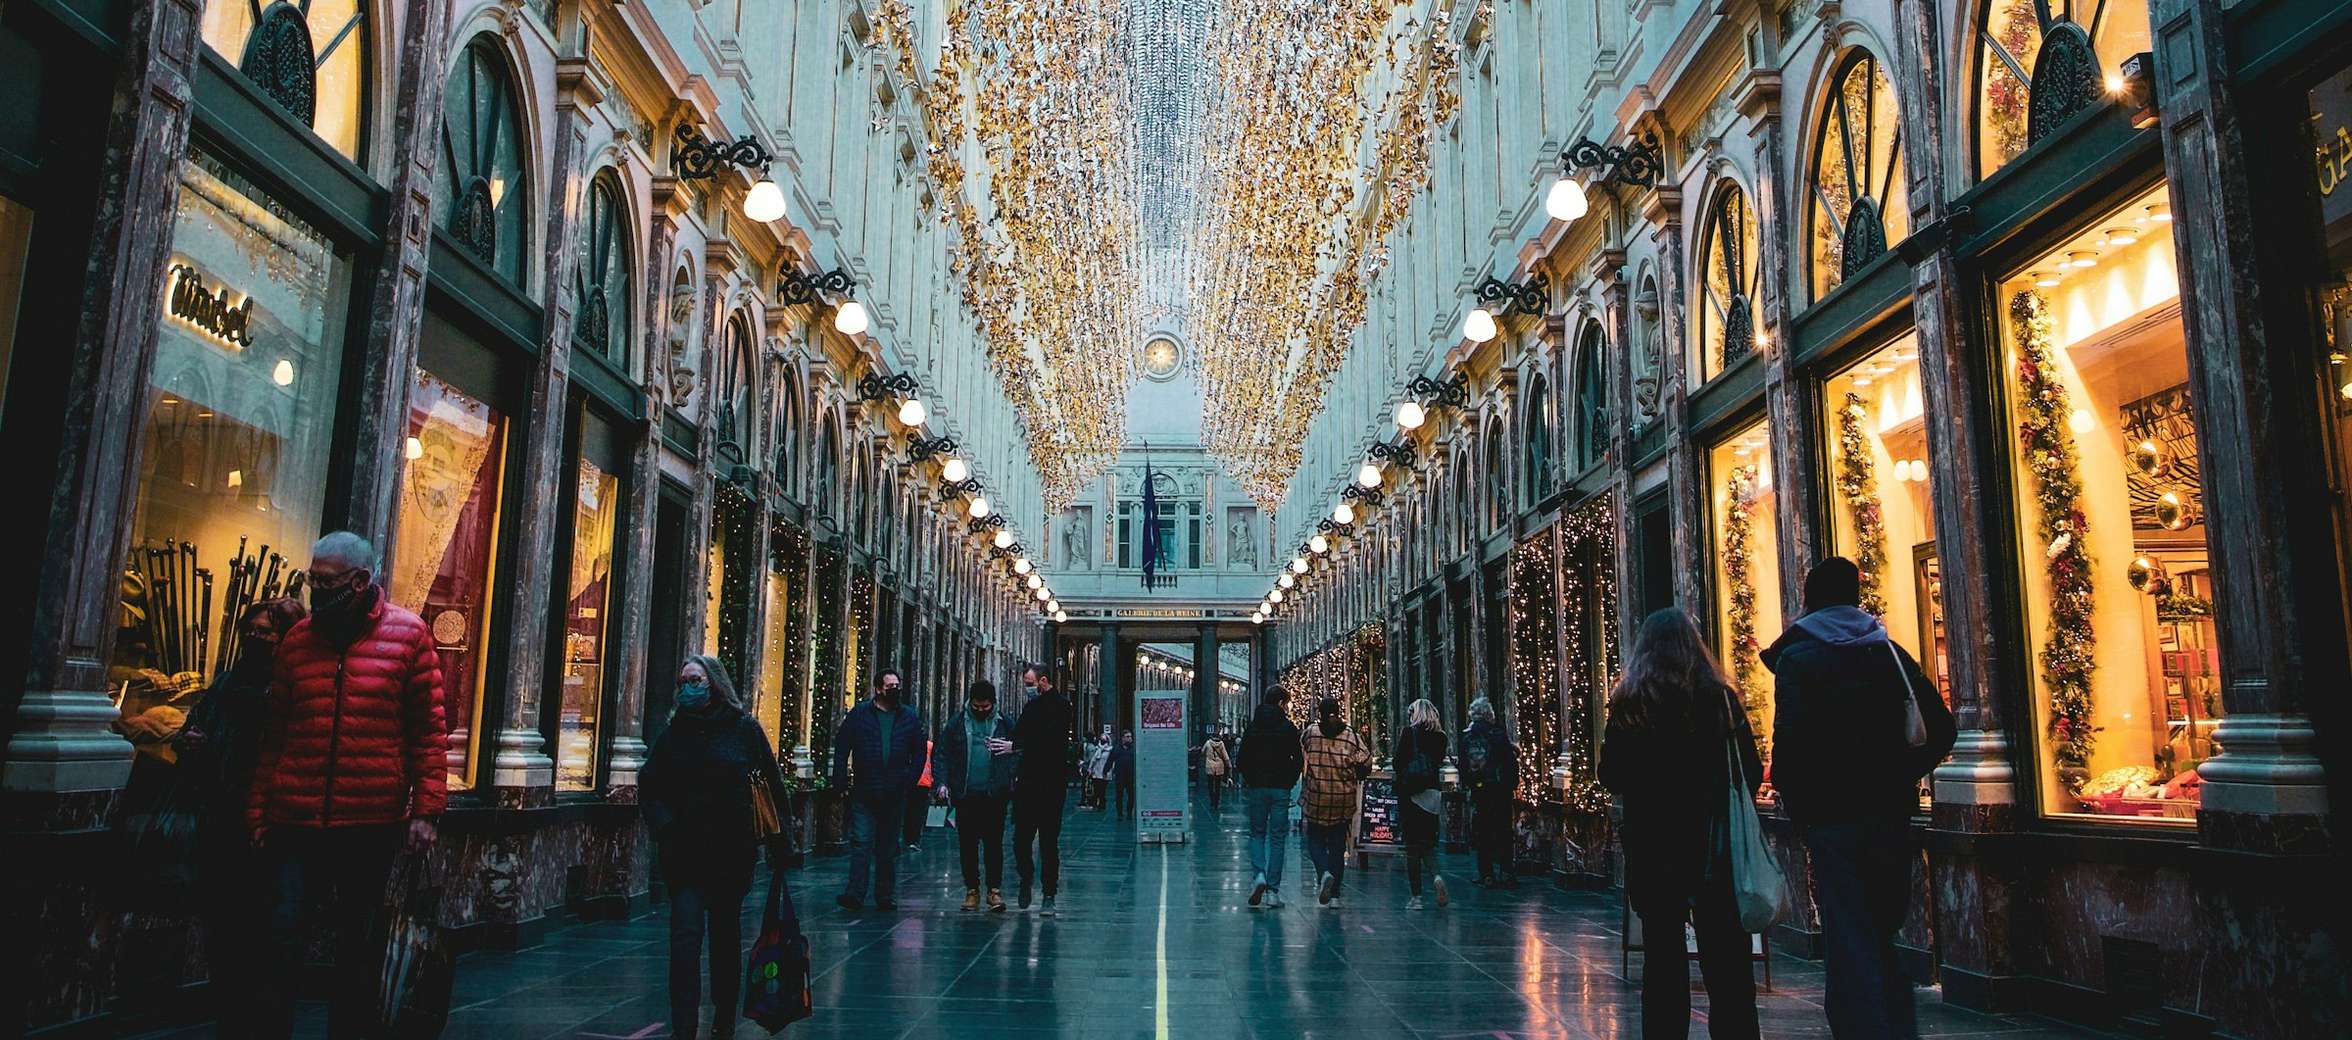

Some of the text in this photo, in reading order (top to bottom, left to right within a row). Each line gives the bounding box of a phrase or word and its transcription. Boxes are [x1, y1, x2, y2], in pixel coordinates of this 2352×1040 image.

[1117, 608, 1201, 617] GALERIE DE LA REINE
